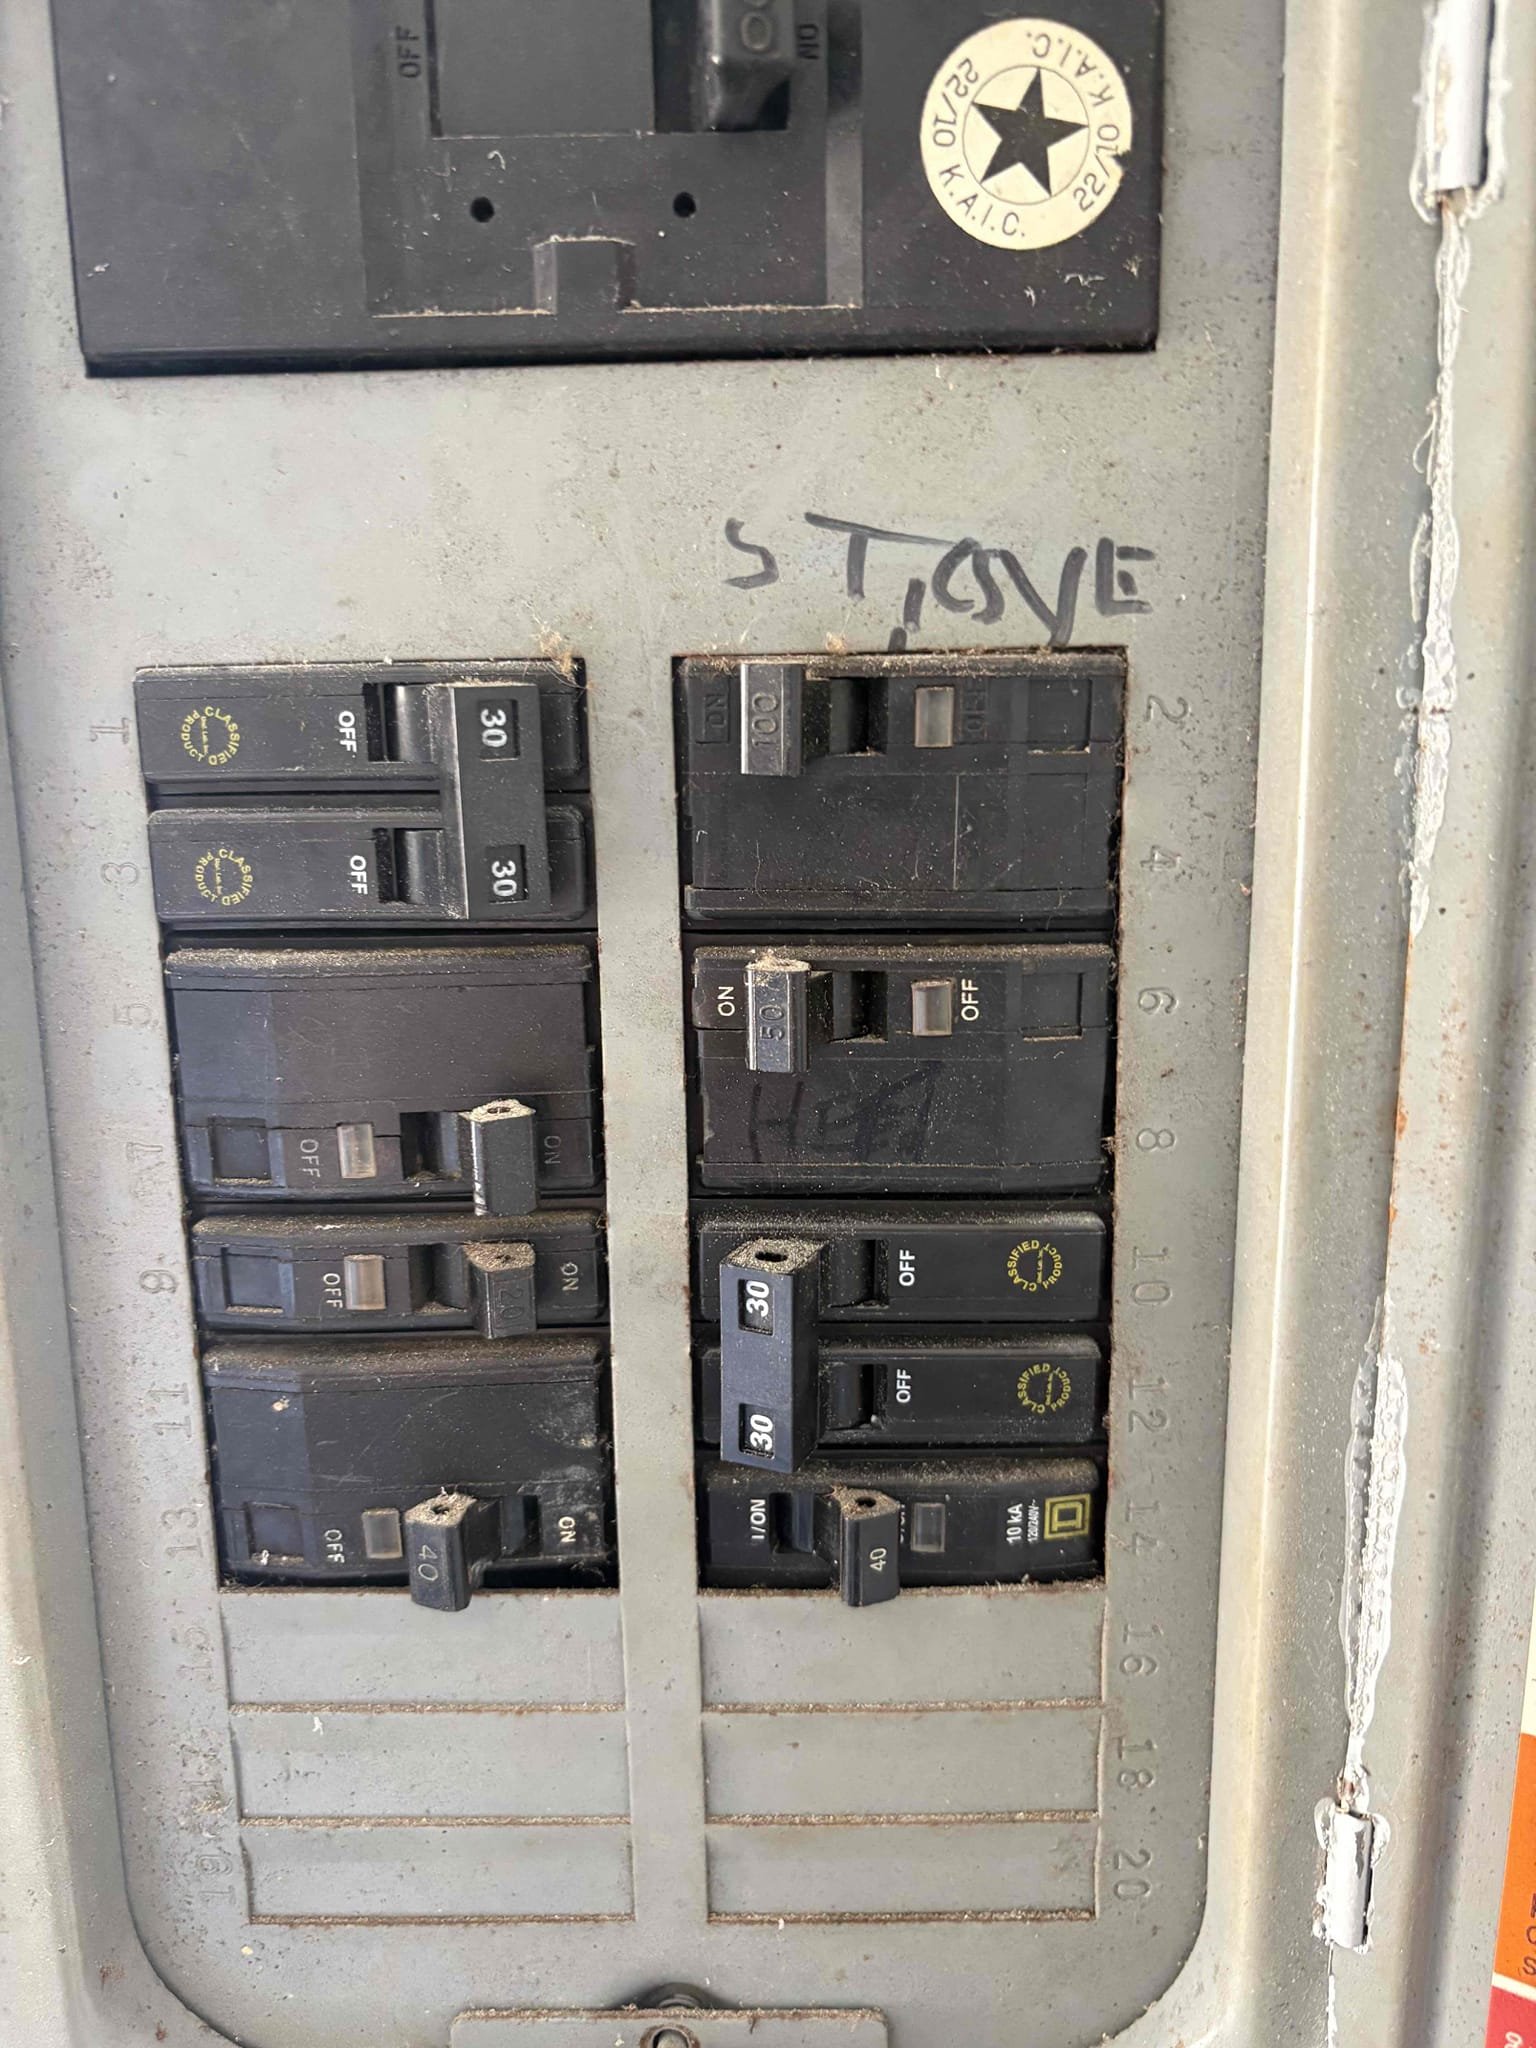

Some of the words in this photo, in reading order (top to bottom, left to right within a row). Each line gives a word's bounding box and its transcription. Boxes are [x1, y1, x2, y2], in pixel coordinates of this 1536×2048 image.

[396, 26, 421, 78] OFF
[798, 24, 819, 60] ON
[933, 57, 979, 147] 22/10
[723, 512, 1156, 647] STOVE
[481, 709, 508, 747] 30
[752, 694, 778, 748] 100
[1145, 695, 1188, 723] 2
[90, 717, 129, 744] 1
[180, 710, 204, 763] PRODUCT
[205, 706, 240, 766] CLASSIFIED
[339, 710, 357, 753] OFF
[102, 862, 139, 885] 3
[195, 851, 218, 902] PRODUCT
[219, 848, 254, 906] CLASSIFIED
[350, 855, 368, 895] OFF
[491, 860, 517, 897] 30
[717, 986, 735, 1017] ON
[961, 978, 979, 1021] OFF
[1138, 986, 1176, 1014] 6
[759, 1004, 784, 1041] 50
[300, 1138, 320, 1178] OFF
[543, 1135, 562, 1165] ON
[1136, 1128, 1176, 1150] 8
[139, 1269, 177, 1294] 9
[561, 1262, 579, 1292] ON
[899, 1249, 915, 1287] OFF
[1007, 1240, 1040, 1292] CLASSIFIED
[1042, 1243, 1062, 1289] PRODUCT
[1132, 1246, 1172, 1304] 10
[322, 1272, 343, 1309] OFF
[746, 1281, 769, 1317] 30
[896, 1369, 911, 1404] OFF
[1017, 1363, 1051, 1414] CLASSIFIED
[1051, 1366, 1071, 1412] PRODUCT
[1128, 1377, 1169, 1433] 12
[750, 1414, 773, 1451] 30
[160, 1508, 203, 1558] 13
[558, 1516, 576, 1543] ON
[1007, 1504, 1022, 1524] kA
[324, 1529, 345, 1564] OFF
[1006, 1527, 1022, 1544] 10
[417, 1543, 439, 1582] 40
[869, 1547, 888, 1572] 40
[1120, 1623, 1162, 1676] 16
[1117, 1736, 1156, 1788] 18
[1113, 1849, 1151, 1899] 20
